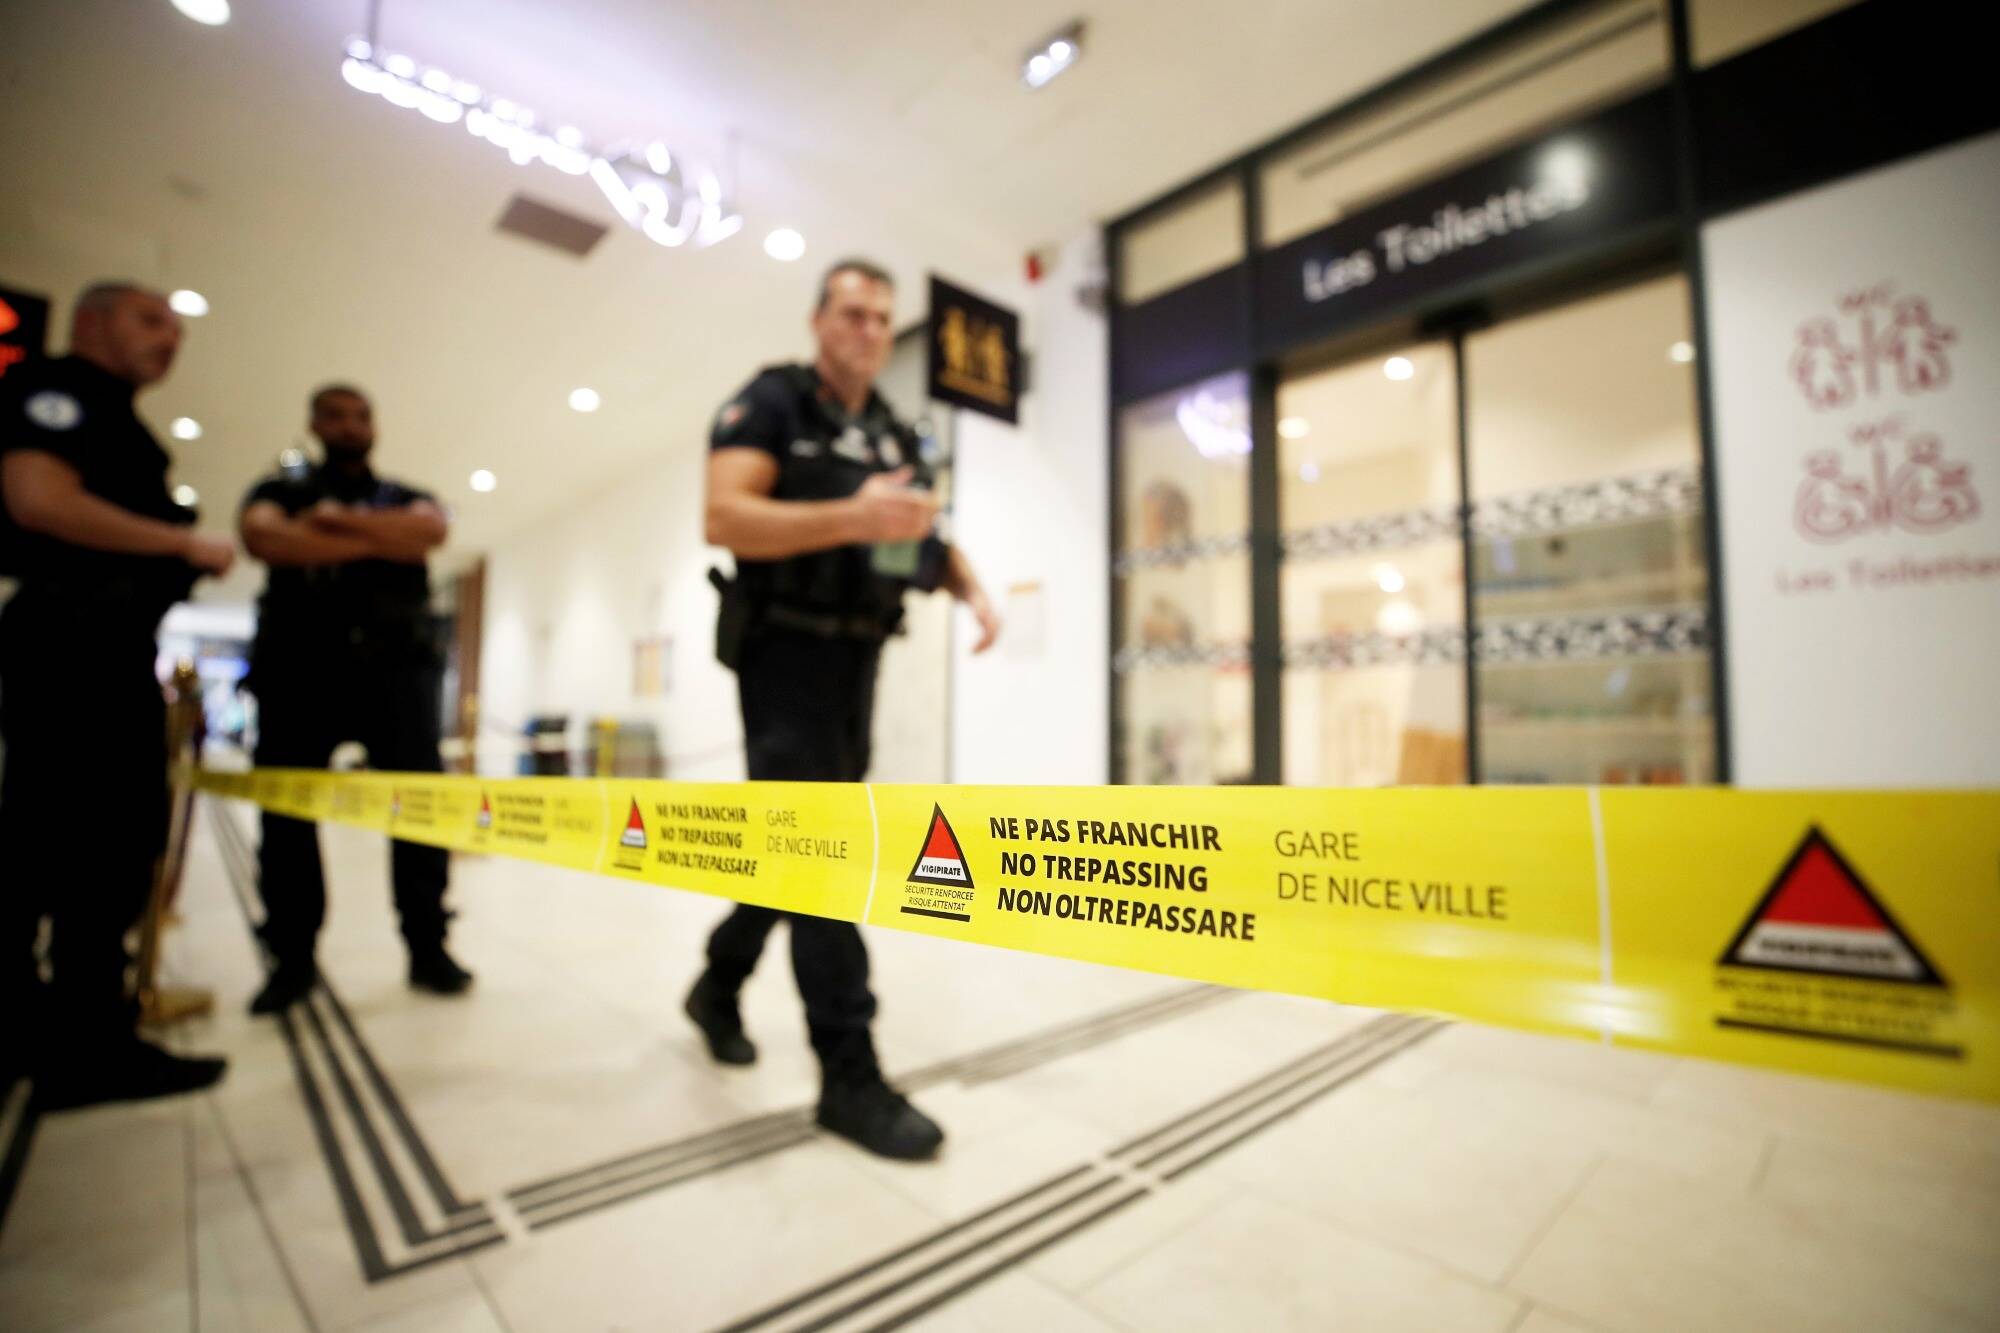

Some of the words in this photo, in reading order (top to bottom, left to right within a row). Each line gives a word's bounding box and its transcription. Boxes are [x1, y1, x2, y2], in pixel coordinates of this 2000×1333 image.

[1303, 249, 1376, 303] Les
[656, 803, 669, 818] NE
[672, 804, 689, 820] PAS
[692, 805, 747, 823] FRANCHIR
[766, 809, 797, 828] GARE
[661, 826, 676, 842] NO
[678, 827, 742, 849] TREPASSING
[989, 817, 1018, 840] NE
[1026, 818, 1070, 843] PAS
[1077, 820, 1222, 851] FRANCHIR
[1275, 830, 1359, 861] GARE
[767, 835, 782, 853] DE
[785, 837, 811, 856] NICE
[814, 840, 847, 859] VILLE
[657, 850, 677, 866] NON
[679, 852, 757, 877] OLTREPASSARE
[921, 864, 961, 876] VIGIPIRATE
[1001, 852, 1036, 877] NO
[1043, 854, 1208, 892] TREPASSING
[904, 885, 934, 896] SECURITE
[935, 888, 974, 901] RENFORCEE
[908, 896, 932, 907] RISQUE
[932, 899, 966, 911] ATTENTAT
[1278, 872, 1317, 902] DE
[1328, 876, 1402, 911] NICE
[1410, 881, 1509, 921] VILLE
[997, 887, 1051, 915] NON
[1055, 893, 1256, 941] OLTREPASSARE
